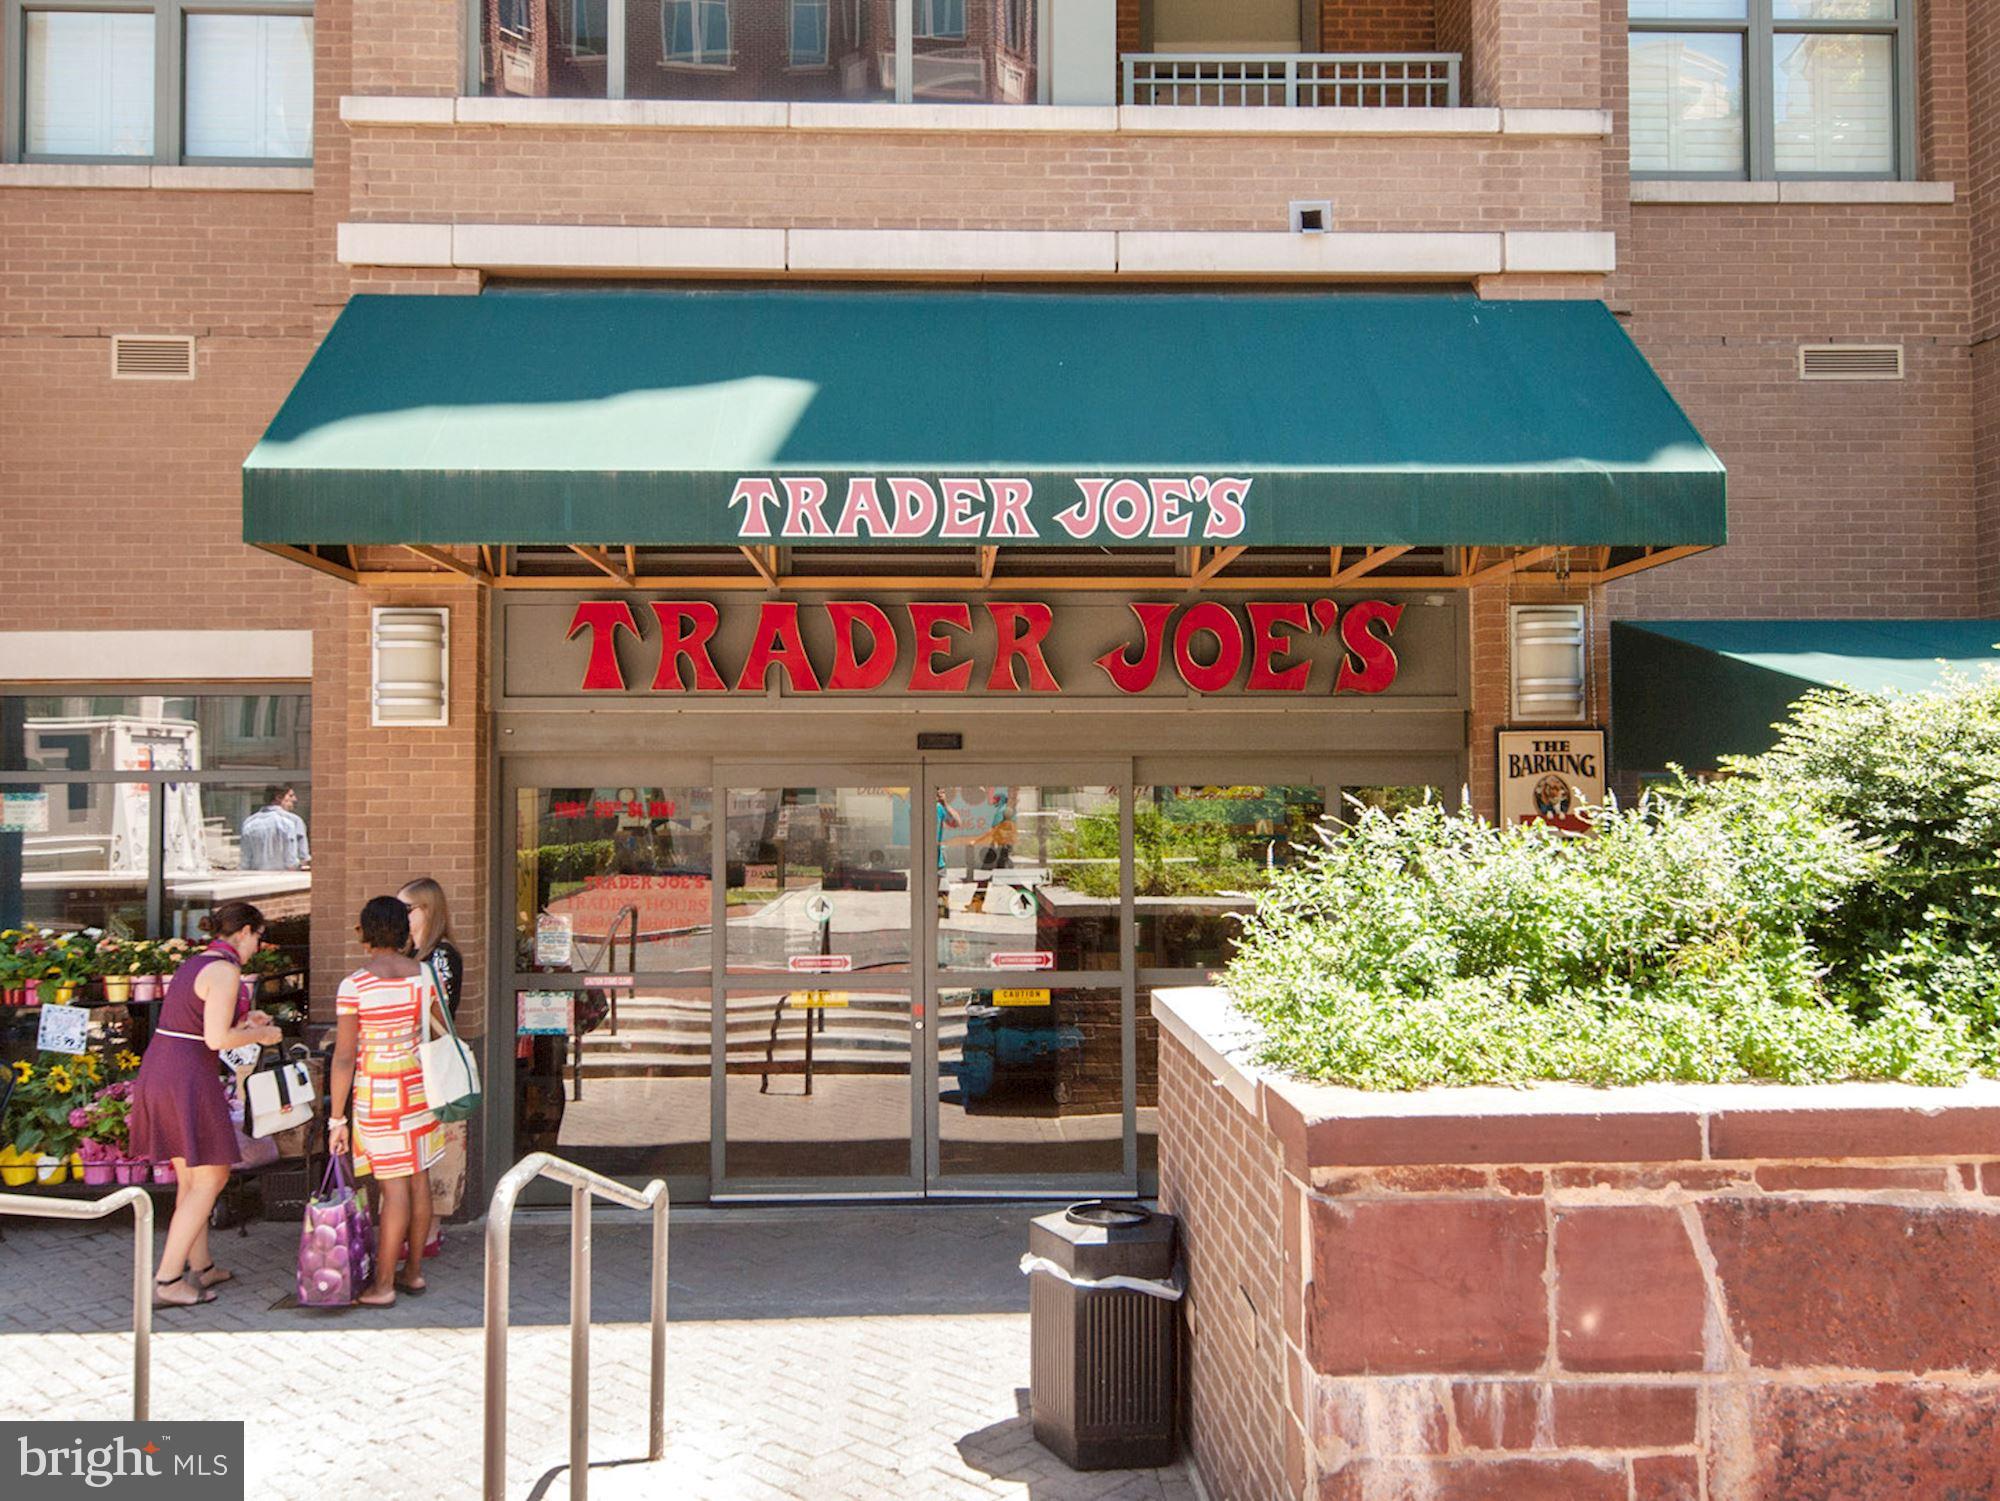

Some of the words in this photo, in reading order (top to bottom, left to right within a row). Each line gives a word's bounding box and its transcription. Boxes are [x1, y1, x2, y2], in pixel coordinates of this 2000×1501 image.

[728, 477, 1039, 538] TRADER
[1052, 475, 1253, 539] JOE'S
[566, 600, 1063, 693] TRADER
[1093, 598, 1406, 695] JOE'S
[1532, 740, 1570, 752] THE
[1508, 754, 1596, 779] BARKING
[584, 875, 653, 890] TRADER
[658, 875, 706, 890] JOE'S
[646, 897, 708, 912] HOURS
